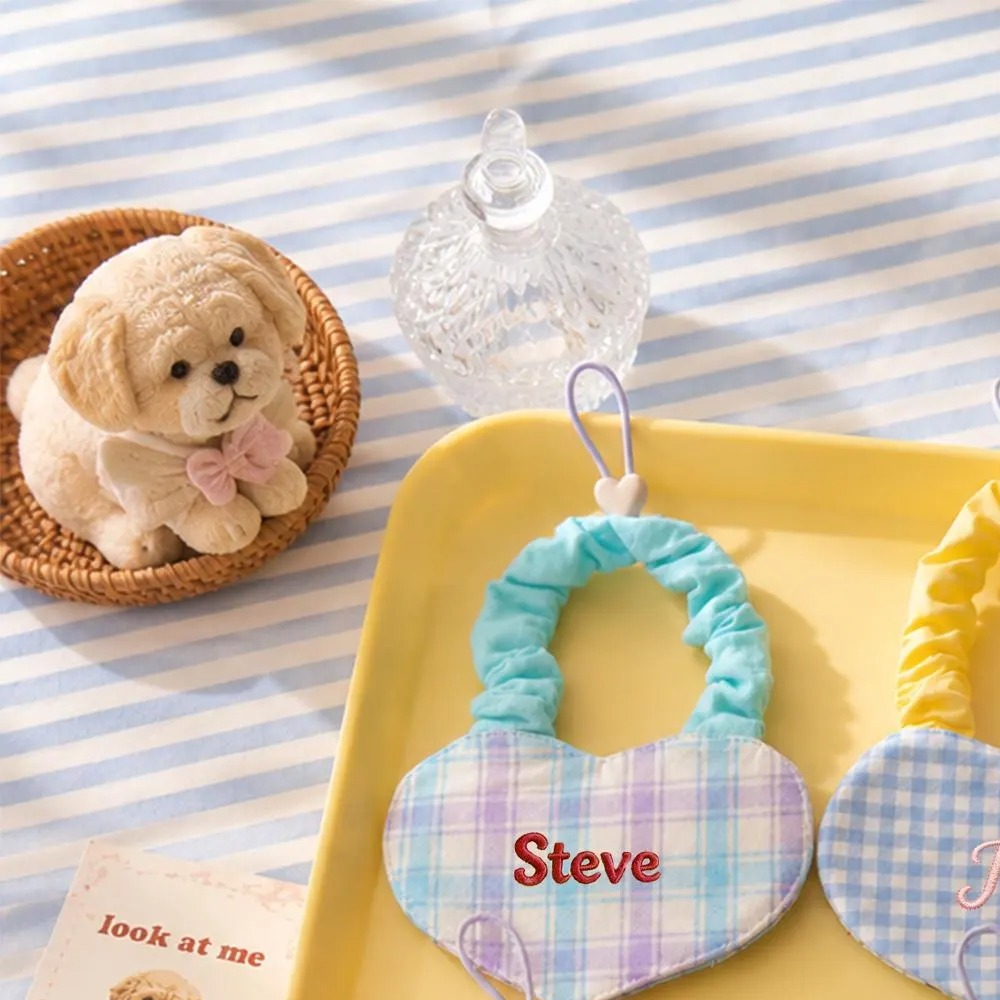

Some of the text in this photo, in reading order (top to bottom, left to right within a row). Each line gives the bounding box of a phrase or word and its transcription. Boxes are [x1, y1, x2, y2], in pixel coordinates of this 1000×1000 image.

[514, 832, 662, 887] Steve
[97, 914, 266, 967] look at me
